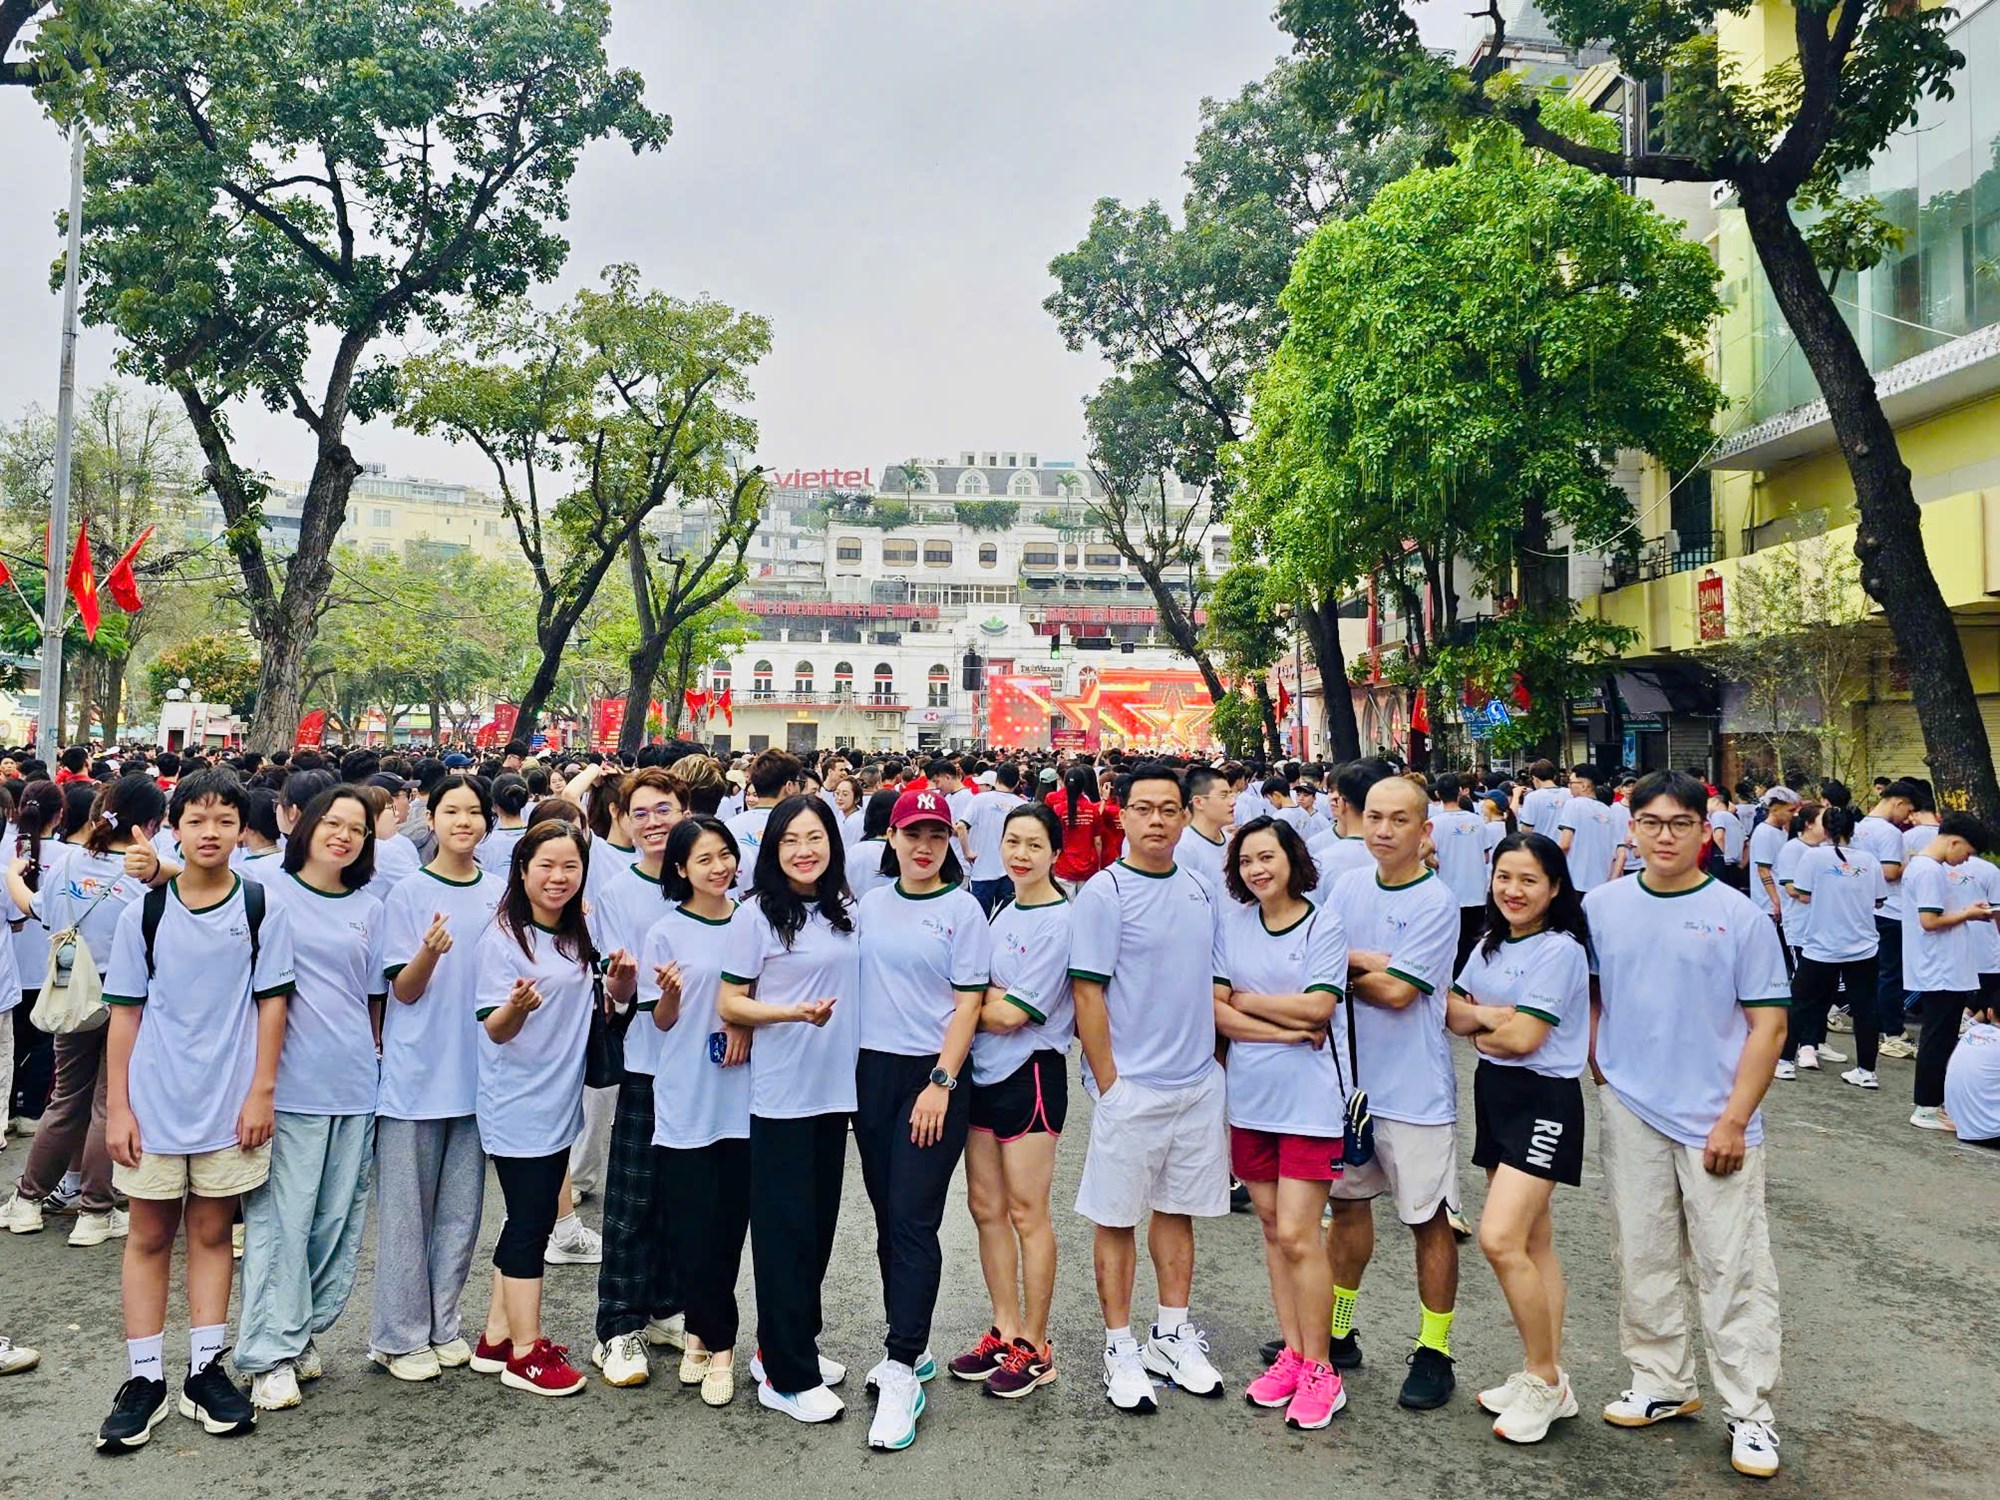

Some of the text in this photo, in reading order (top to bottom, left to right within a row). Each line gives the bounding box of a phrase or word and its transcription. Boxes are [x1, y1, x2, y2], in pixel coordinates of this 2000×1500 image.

[774, 467, 874, 489] viettel
[1700, 587, 1722, 609] MINI
[1526, 1118, 1563, 1169] RUN
